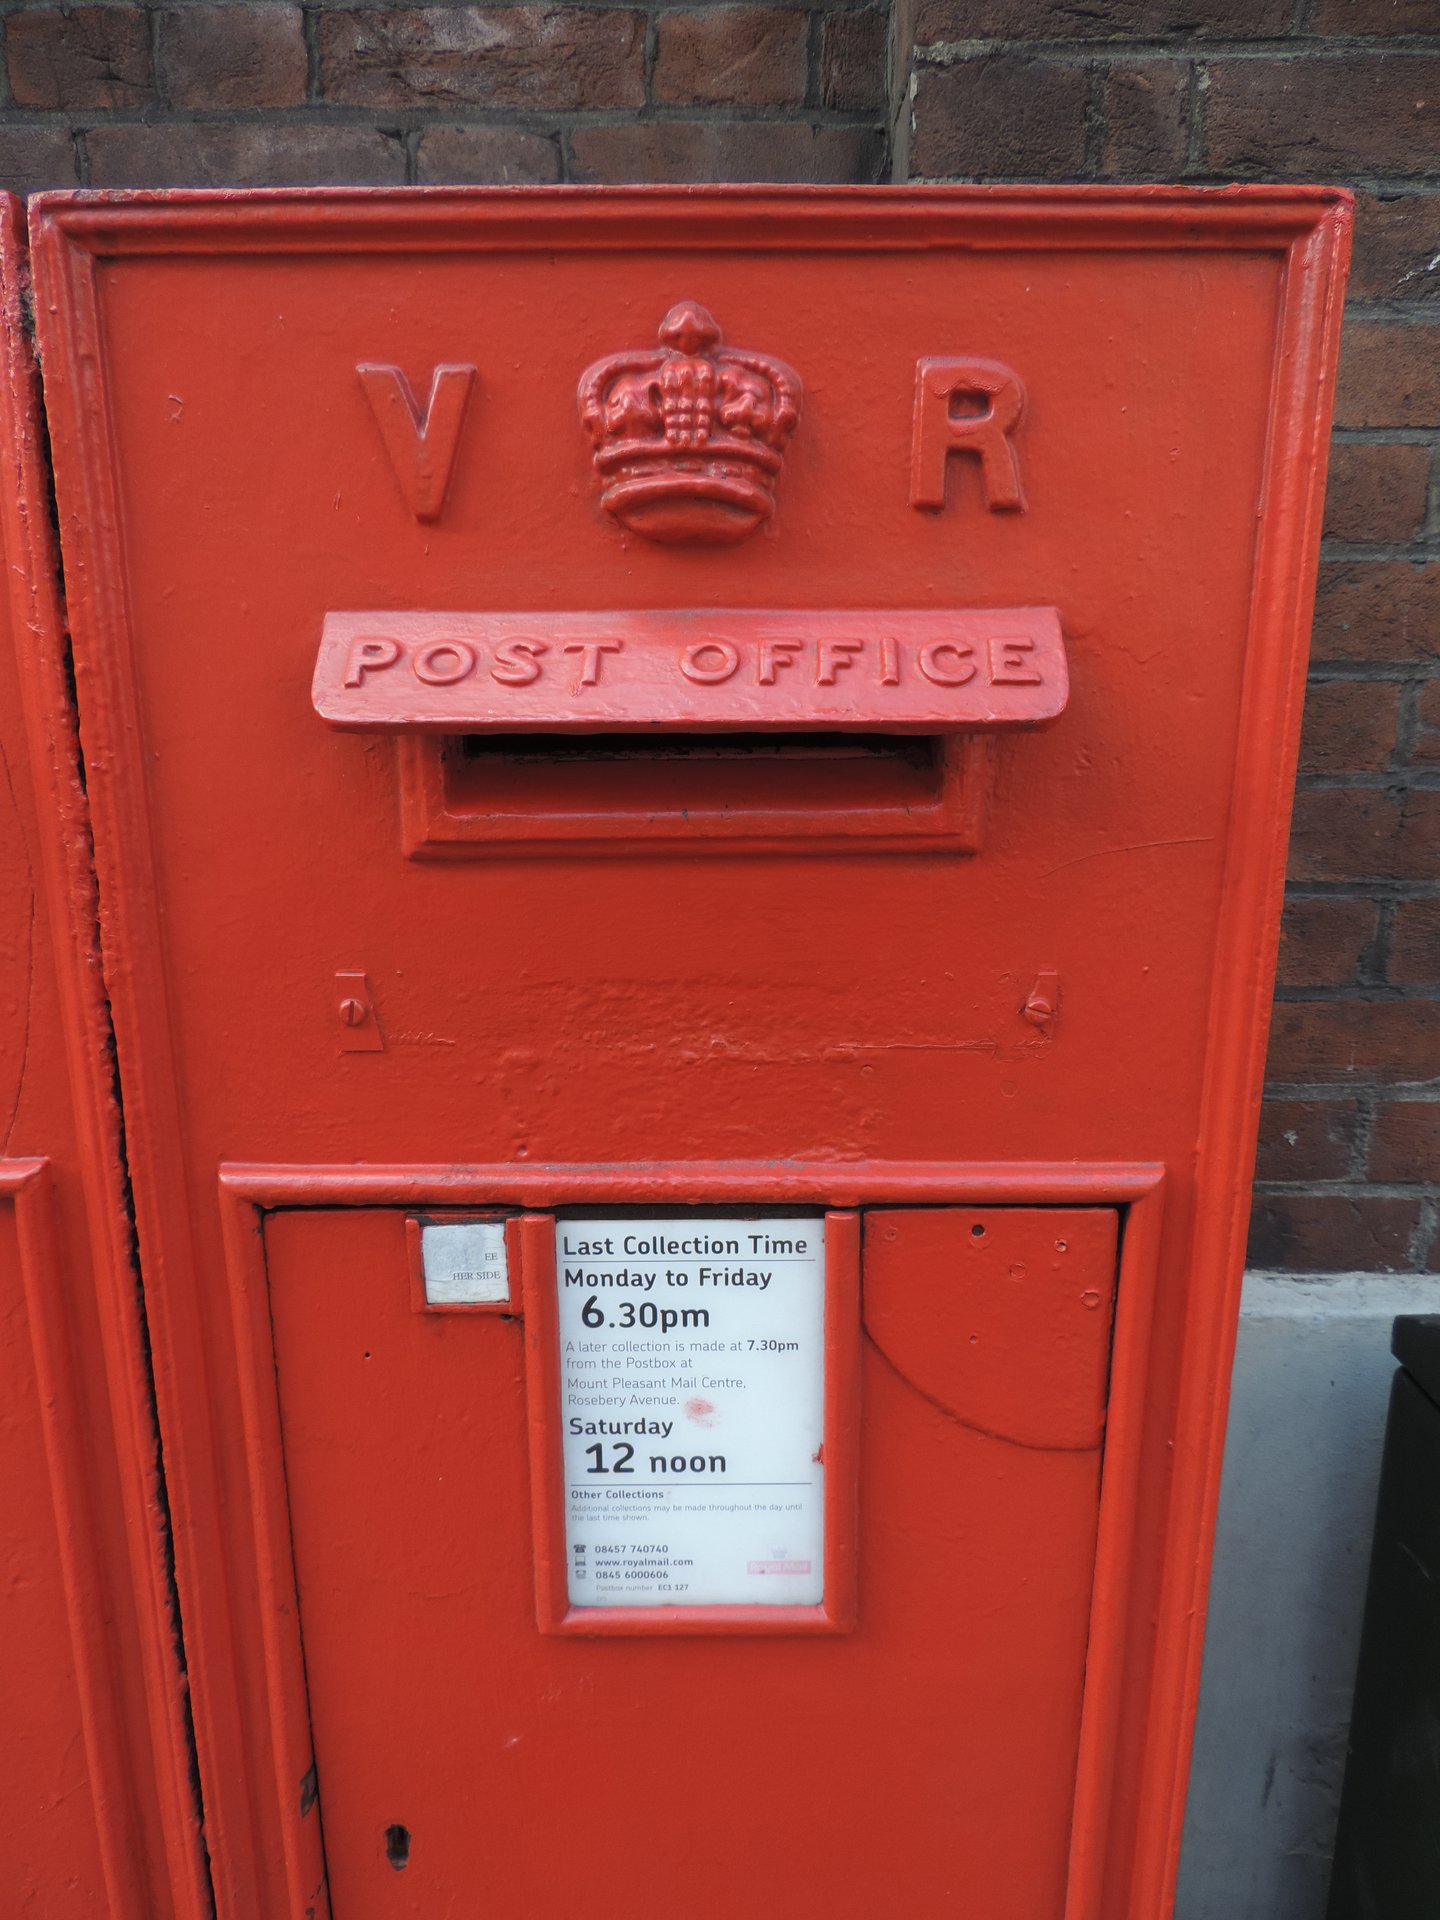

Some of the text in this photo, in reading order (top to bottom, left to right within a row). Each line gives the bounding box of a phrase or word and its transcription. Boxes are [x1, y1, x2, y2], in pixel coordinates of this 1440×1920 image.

[356, 354, 1030, 524] V R
[342, 635, 1042, 690] POST OFFICE
[563, 1235, 808, 1255] Last Collection Time
[476, 1271, 501, 1280] SIDE
[564, 1267, 772, 1291] Monday to Friday
[581, 1295, 710, 1333] 6.30pm
[566, 1339, 799, 1353] A later collection is made at 7.30pm
[566, 1357, 693, 1369] from the Postbox at
[567, 1376, 746, 1389] Mount Pleasant Mail Centre,
[568, 1394, 680, 1408] Rosebery Avenue.
[569, 1417, 673, 1438] Saturday
[585, 1442, 726, 1474] 12 noon
[571, 1490, 664, 1499] Other Collections
[571, 1504, 609, 1512] Additional
[611, 1504, 651, 1512] collections
[654, 1505, 670, 1513] may
[709, 1503, 751, 1512] throughout
[754, 1503, 767, 1511] the
[769, 1503, 783, 1512] day
[785, 1503, 803, 1511] until
[594, 1545, 669, 1553] 08457 740740
[595, 1558, 694, 1568] www.royalmail.com
[595, 1570, 669, 1579] 0845 6000606
